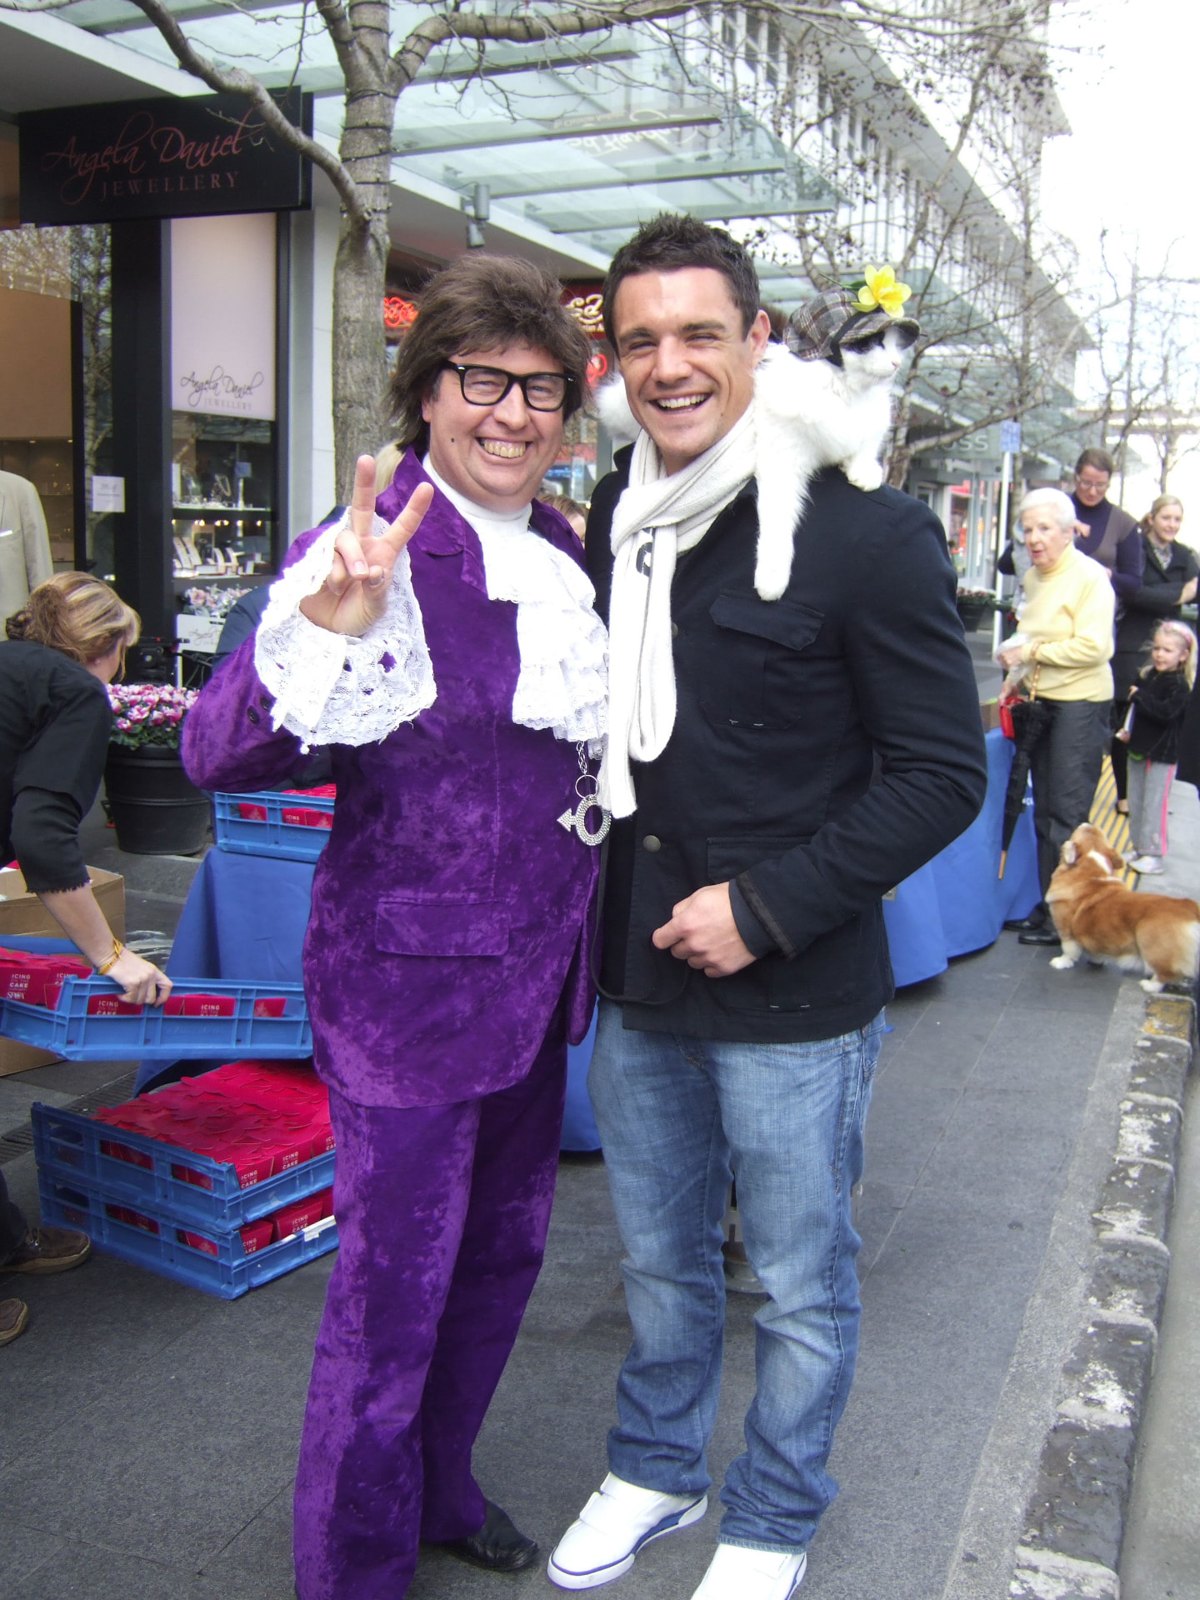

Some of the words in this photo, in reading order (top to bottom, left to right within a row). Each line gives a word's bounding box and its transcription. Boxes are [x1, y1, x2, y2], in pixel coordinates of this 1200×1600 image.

[41, 111, 153, 205] Angela
[150, 105, 264, 170] Daniel
[103, 171, 239, 198] JEWELLERY
[180, 365, 224, 407] Angela
[222, 371, 264, 399] Daniel
[98, 1000, 119, 1008] ICING
[282, 1151, 299, 1161] ICING
[241, 1169, 258, 1180] ICING
[243, 1238, 257, 1247] CING
